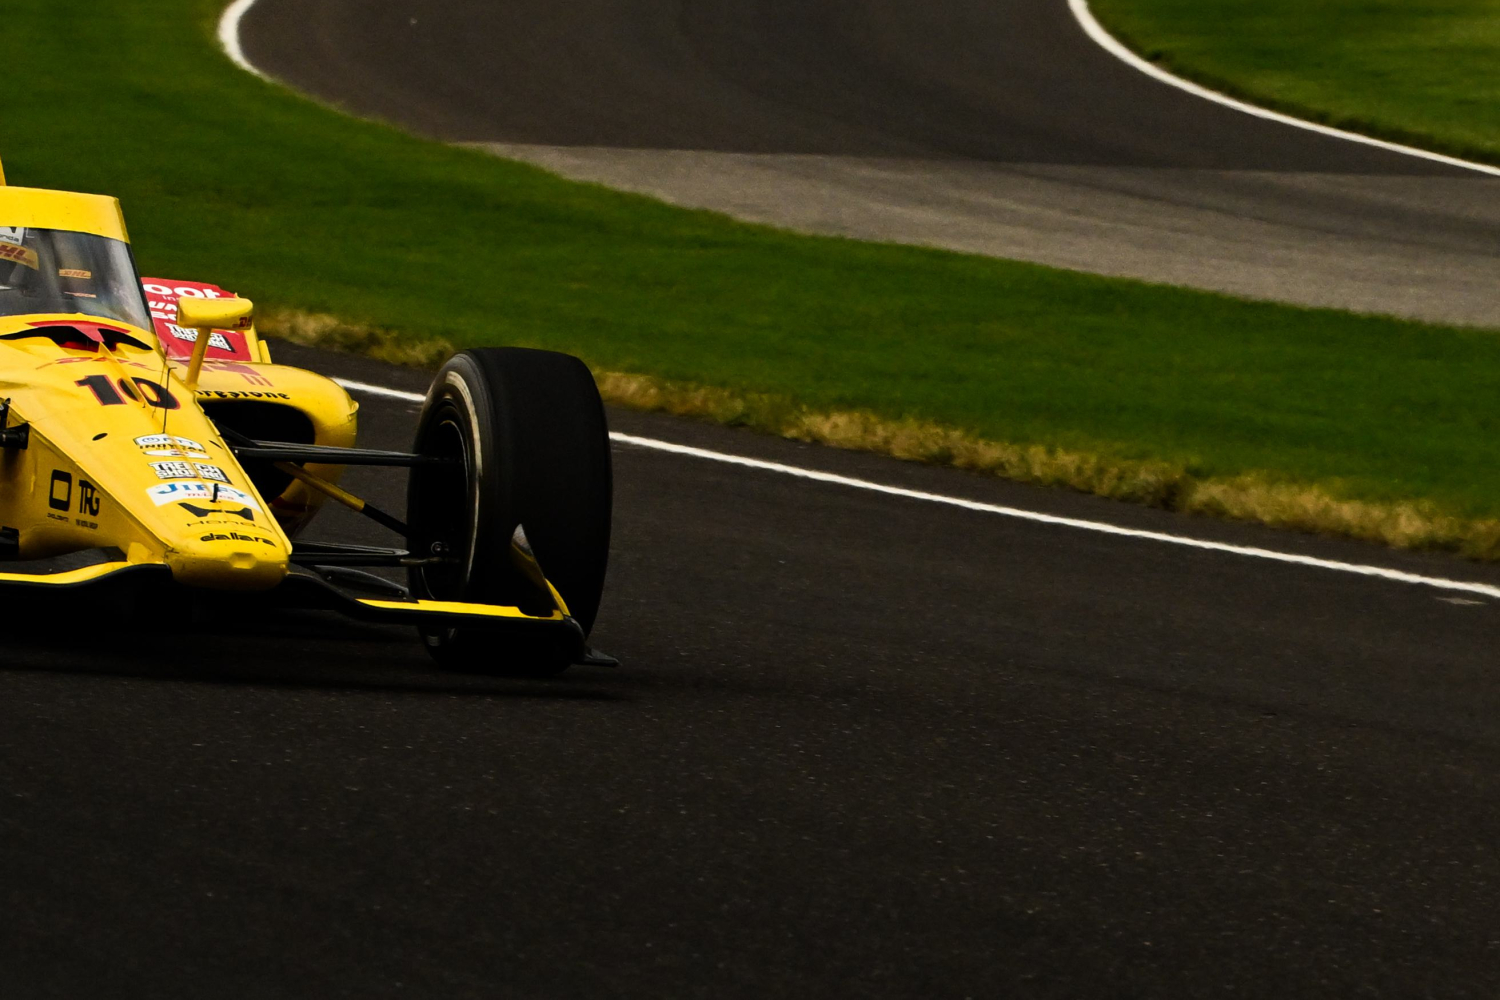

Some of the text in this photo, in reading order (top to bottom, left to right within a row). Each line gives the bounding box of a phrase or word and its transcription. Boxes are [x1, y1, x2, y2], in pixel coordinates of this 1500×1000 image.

[75, 374, 181, 410] 10
[193, 389, 291, 400] irestone
[200, 532, 277, 547] dallara
